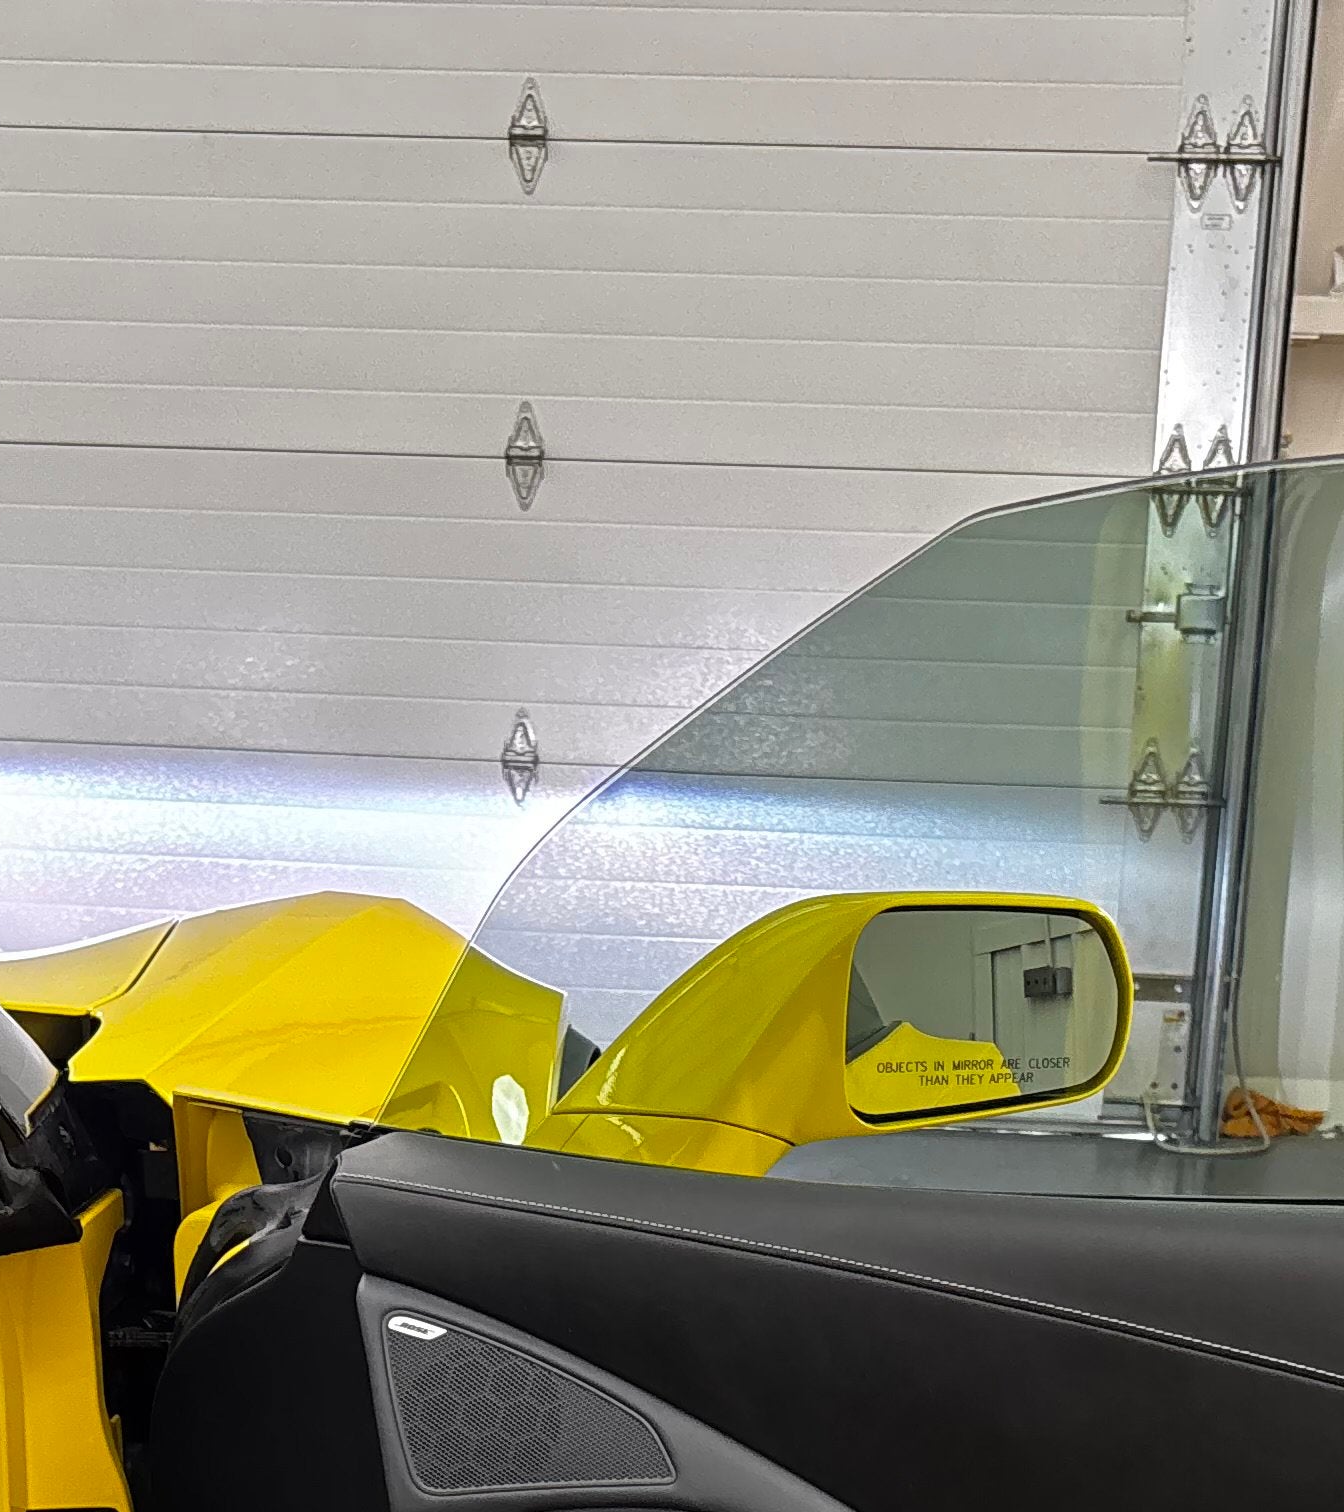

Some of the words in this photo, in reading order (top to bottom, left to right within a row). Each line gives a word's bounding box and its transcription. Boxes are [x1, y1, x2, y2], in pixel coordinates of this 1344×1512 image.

[876, 1061, 928, 1074] OBJECTS
[934, 1060, 945, 1072] IN
[952, 1059, 994, 1071] MIRROR
[1000, 1058, 1021, 1070] ARE
[1028, 1056, 1071, 1069] CLOSER
[919, 1074, 949, 1086] THAN
[956, 1073, 985, 1085] THEY
[989, 1072, 1034, 1084] APPEAR
